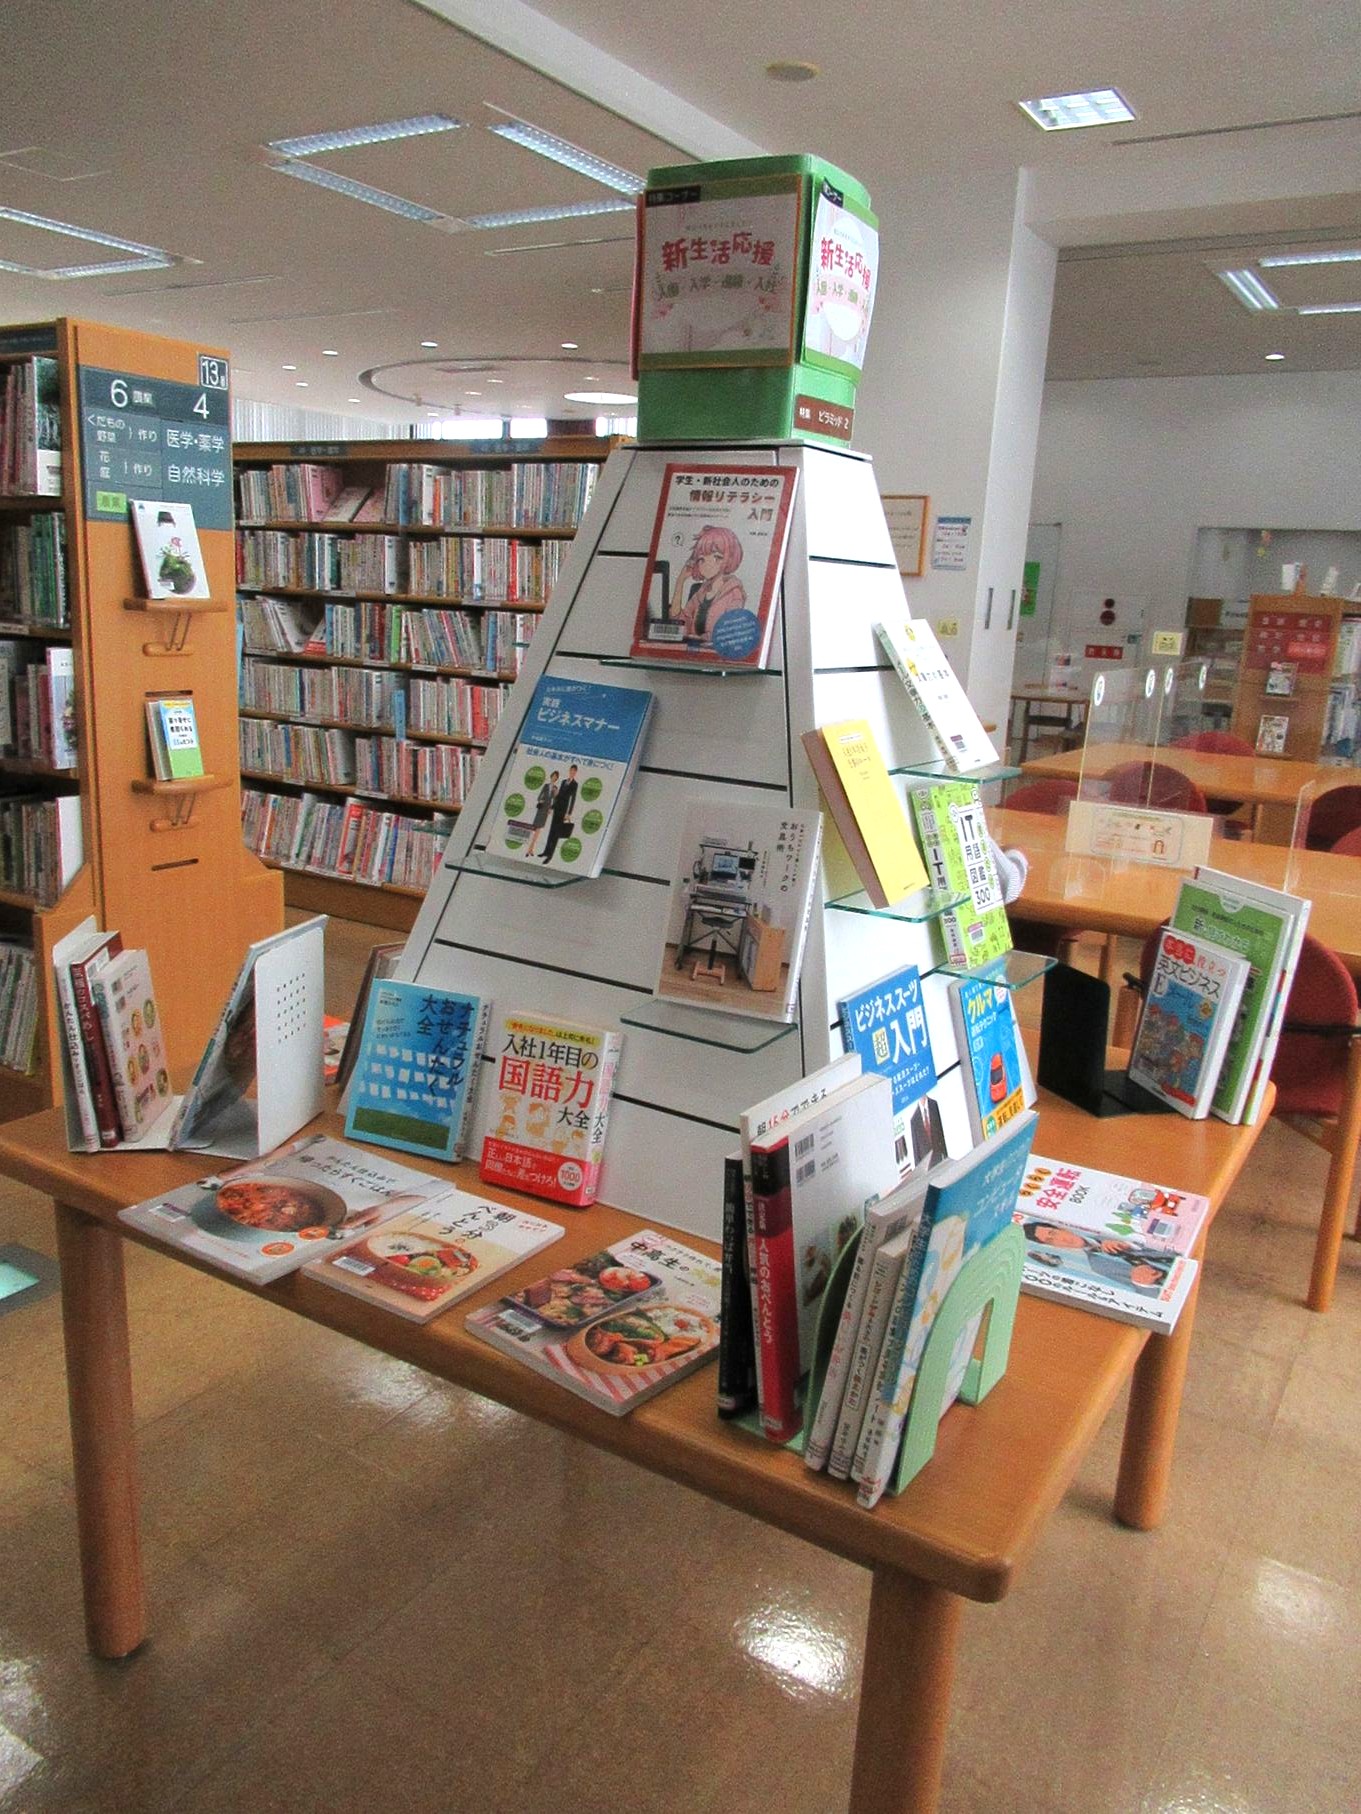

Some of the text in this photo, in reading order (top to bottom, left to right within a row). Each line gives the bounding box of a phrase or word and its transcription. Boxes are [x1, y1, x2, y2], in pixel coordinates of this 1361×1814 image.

[661, 232, 775, 272] 新生活応援
[820, 236, 872, 293] 新生活応援
[111, 379, 128, 408] 6
[192, 392, 210, 420] 4
[87, 414, 126, 430] くだもの
[96, 430, 116, 443] 野菜
[138, 429, 158, 442] 作り
[166, 429, 225, 453] 医学・薬学
[99, 450, 111, 463] 花
[133, 464, 153, 477] 作り
[168, 464, 226, 487] 自然科学
[675, 475, 779, 487] 学生・新社会人のための
[689, 489, 775, 504] 情報リテラシー
[747, 508, 774, 522] 入門
[537, 707, 620, 732] ビジネスマナー
[779, 822, 799, 892] おうちワークの
[1157, 954, 1221, 999] 英文ビジネス
[416, 993, 439, 1037] 大全
[854, 978, 918, 1033] ビジネススーツ
[966, 987, 994, 1025] クルマ
[445, 1001, 475, 1088] ナチュラル
[501, 1033, 599, 1071] 入社1年目の
[498, 1055, 594, 1109] 国語力
[557, 1106, 590, 1131] 大全
[591, 1115, 606, 1145] 大全
[1035, 1167, 1081, 1211] 安全運転
[1068, 1185, 1091, 1205] BOOK
[438, 1204, 498, 1235] べんとう
[630, 1240, 690, 1273] 中高生の
